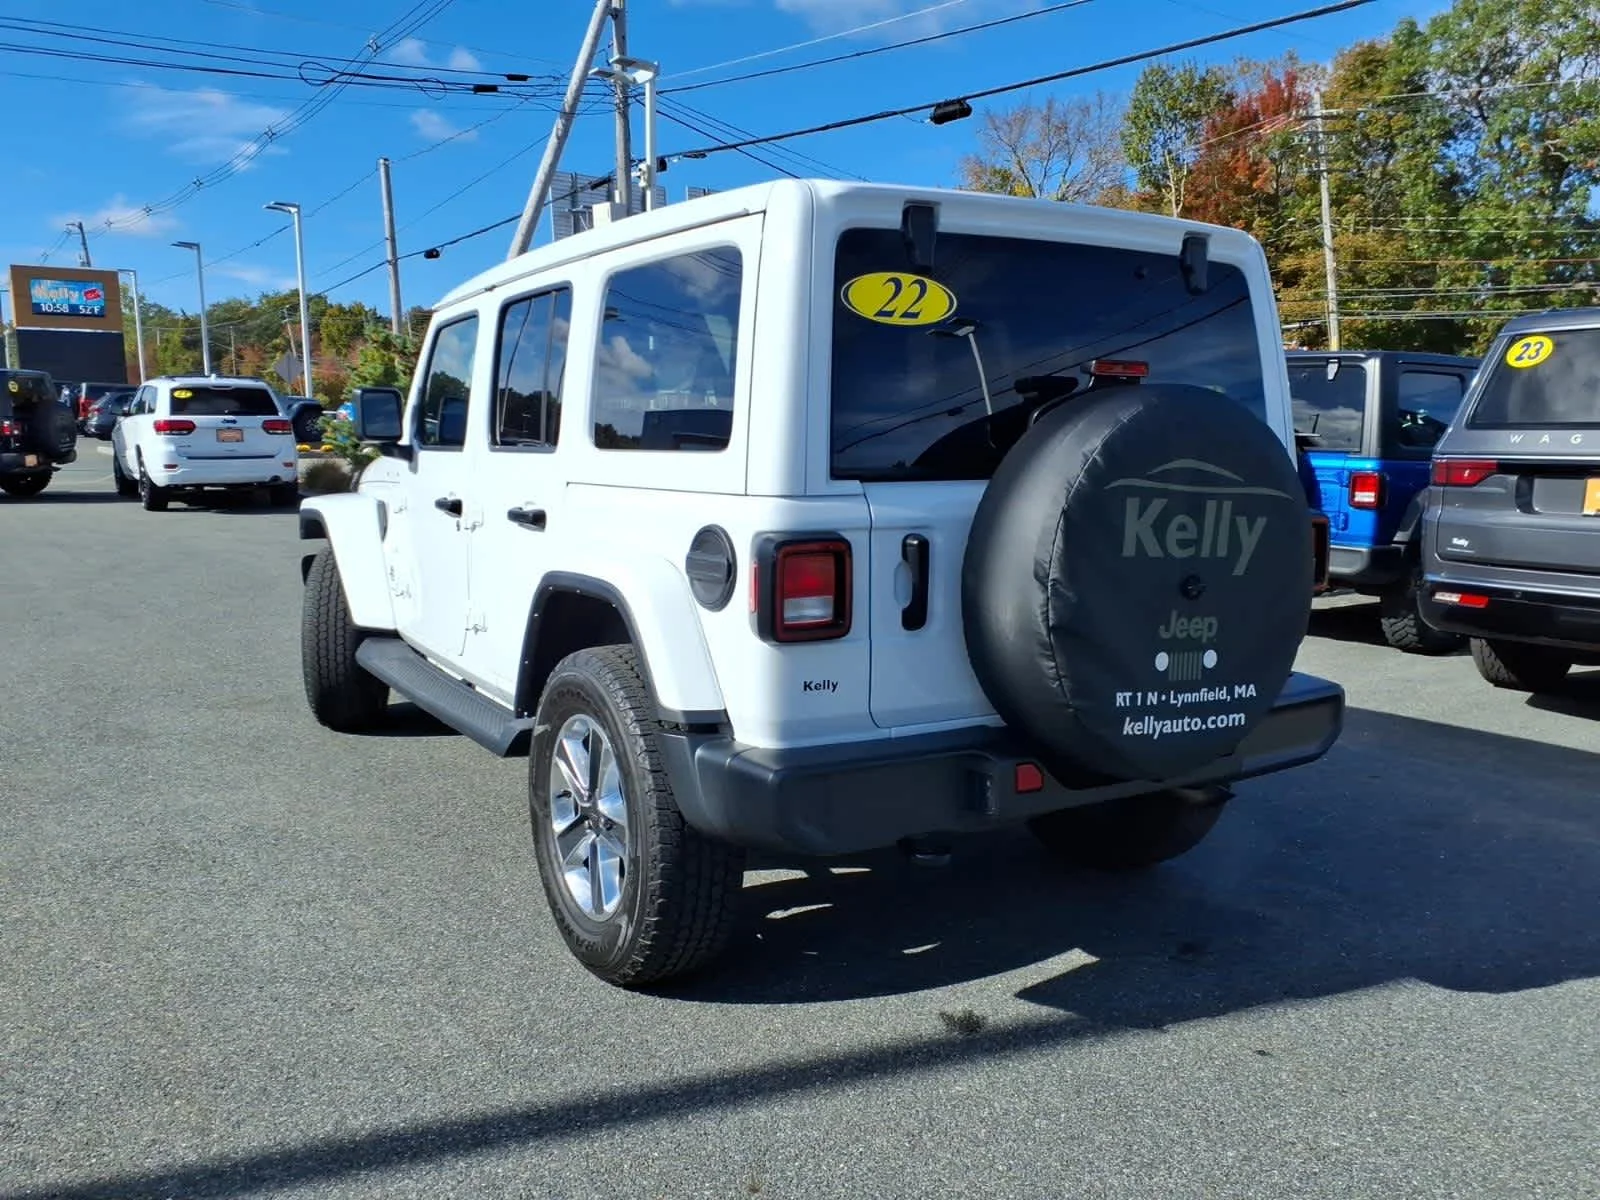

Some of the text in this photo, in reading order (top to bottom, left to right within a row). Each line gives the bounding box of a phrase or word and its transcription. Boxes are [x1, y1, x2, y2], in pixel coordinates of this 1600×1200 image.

[40, 303, 69, 313] 10:58
[873, 277, 928, 319] 22
[1514, 341, 1545, 362] 23
[1121, 497, 1267, 576] Kelly
[1159, 609, 1218, 643] Jeep
[803, 679, 839, 693] Kelly
[1115, 692, 1133, 707] RT
[1136, 692, 1142, 706] 1
[1169, 686, 1231, 707] Lynnfield,
[1234, 684, 1257, 699] MA
[1123, 713, 1246, 740] kellyauto.com
